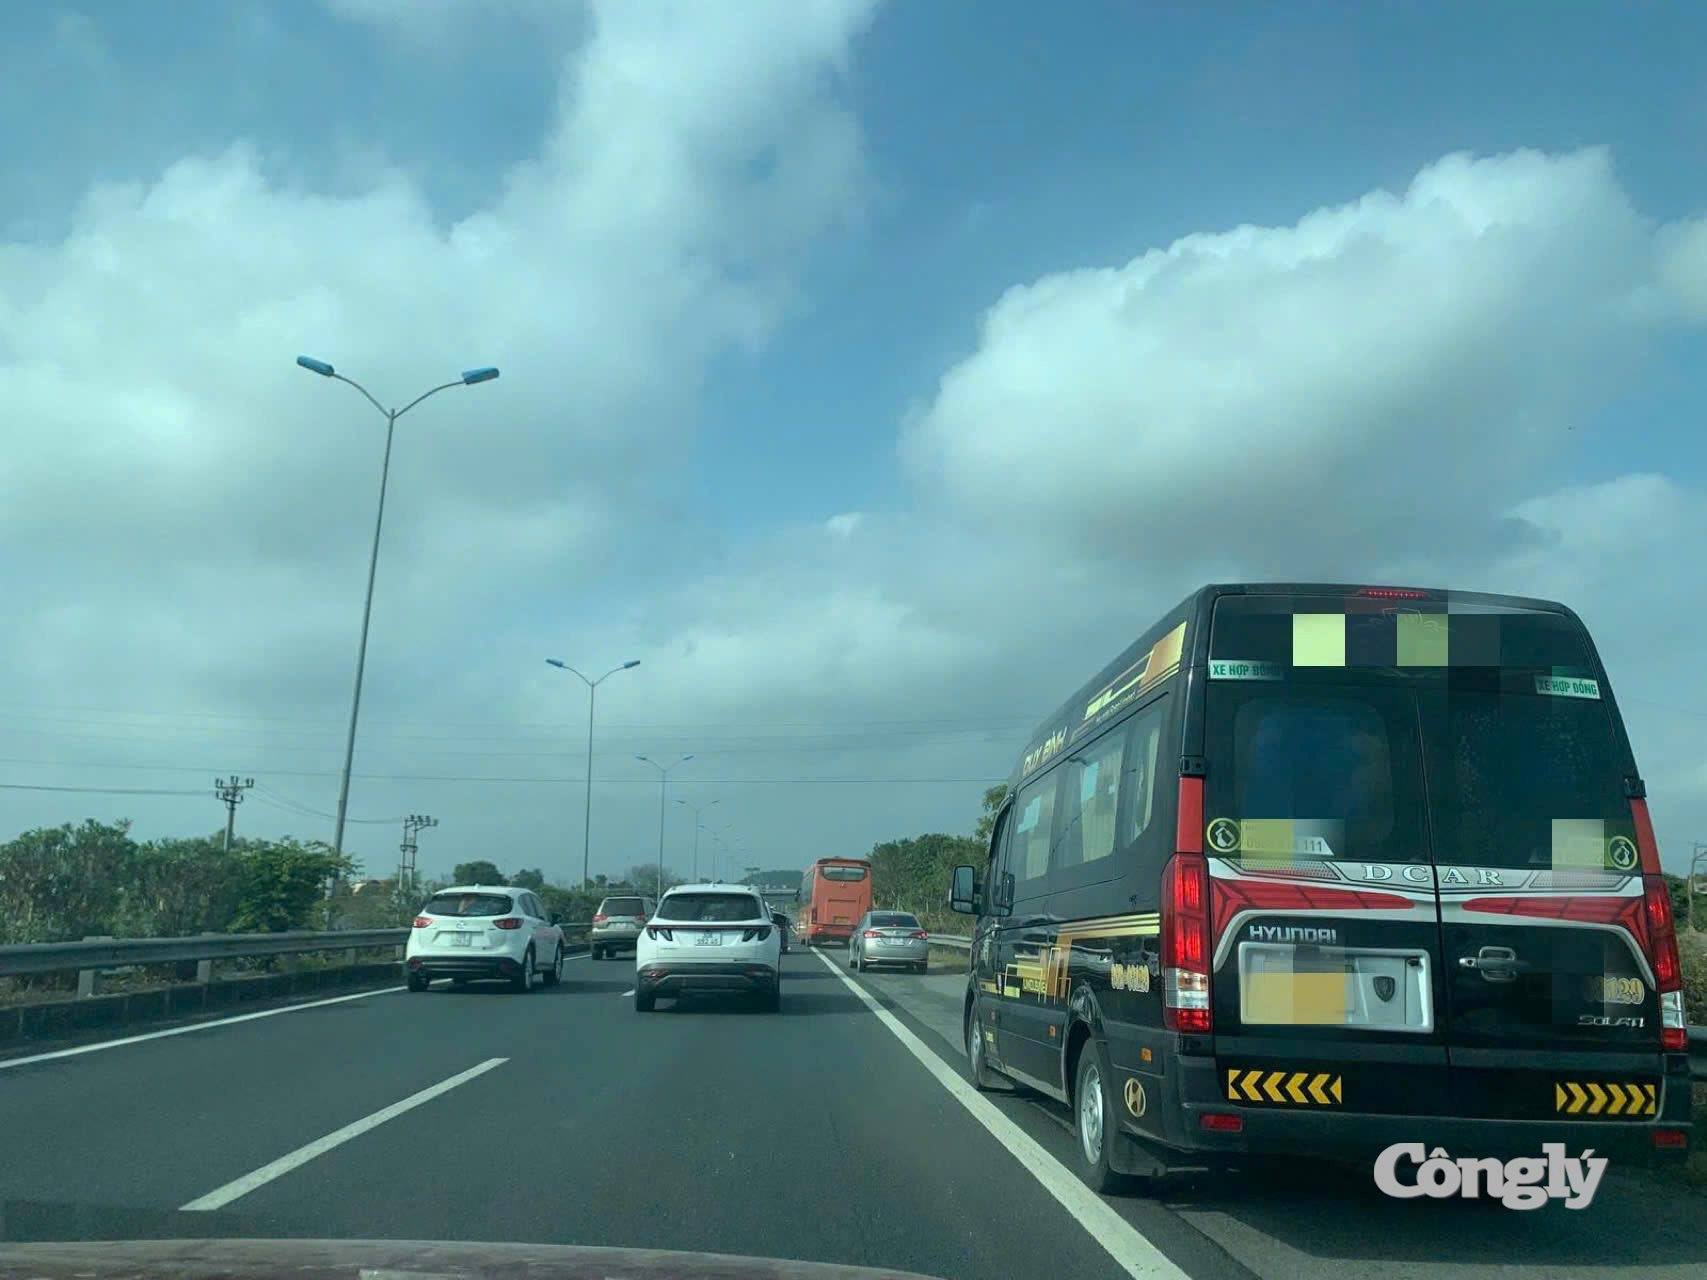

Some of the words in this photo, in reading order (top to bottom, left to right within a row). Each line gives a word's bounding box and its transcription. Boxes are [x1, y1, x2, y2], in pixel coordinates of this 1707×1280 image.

[1212, 664, 1226, 676] XE
[1538, 679, 1551, 691] XE
[1362, 862, 1504, 886] DCAR
[1249, 925, 1337, 944] HYUNDAI
